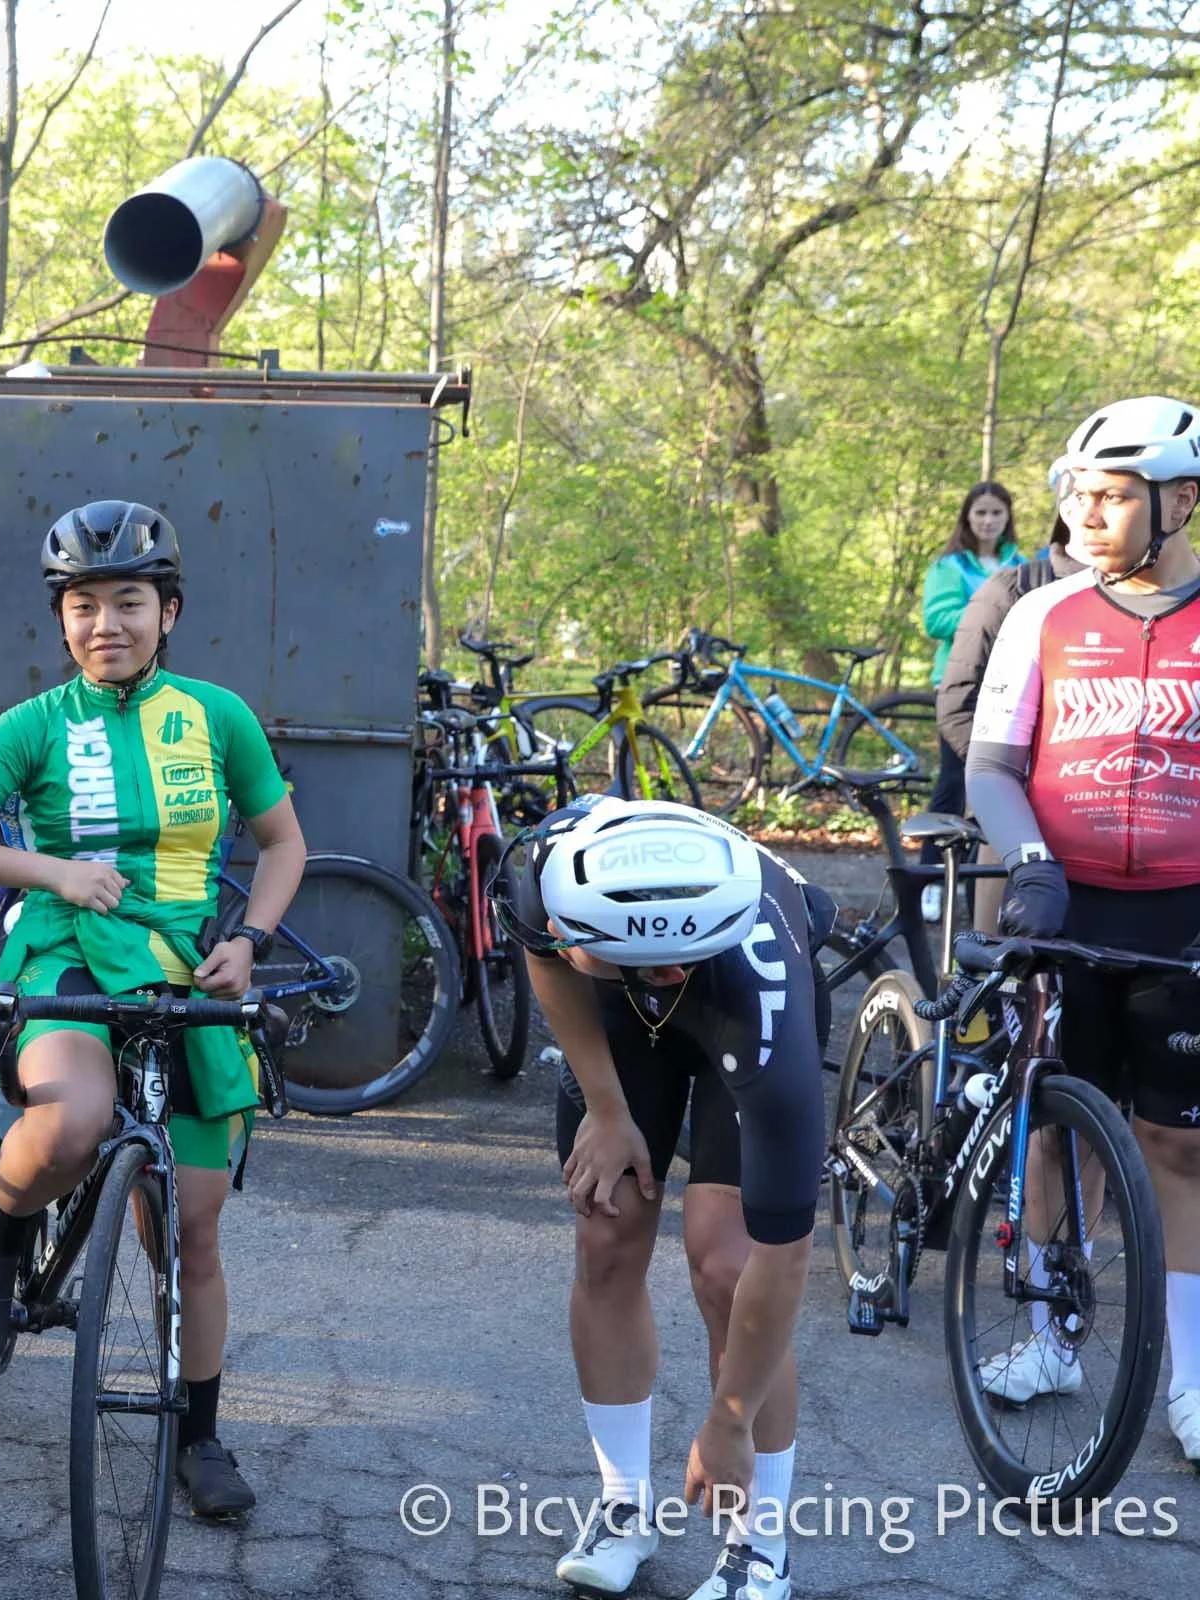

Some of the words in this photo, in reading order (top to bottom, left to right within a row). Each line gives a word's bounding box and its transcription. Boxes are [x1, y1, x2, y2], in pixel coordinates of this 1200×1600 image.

[65, 715, 119, 842] TRACK
[169, 766, 200, 782] 100%
[164, 789, 213, 807] LAZER
[1063, 790, 1111, 803] DUBIN
[167, 807, 216, 827] FOUNDATION
[599, 841, 707, 871] GIRO
